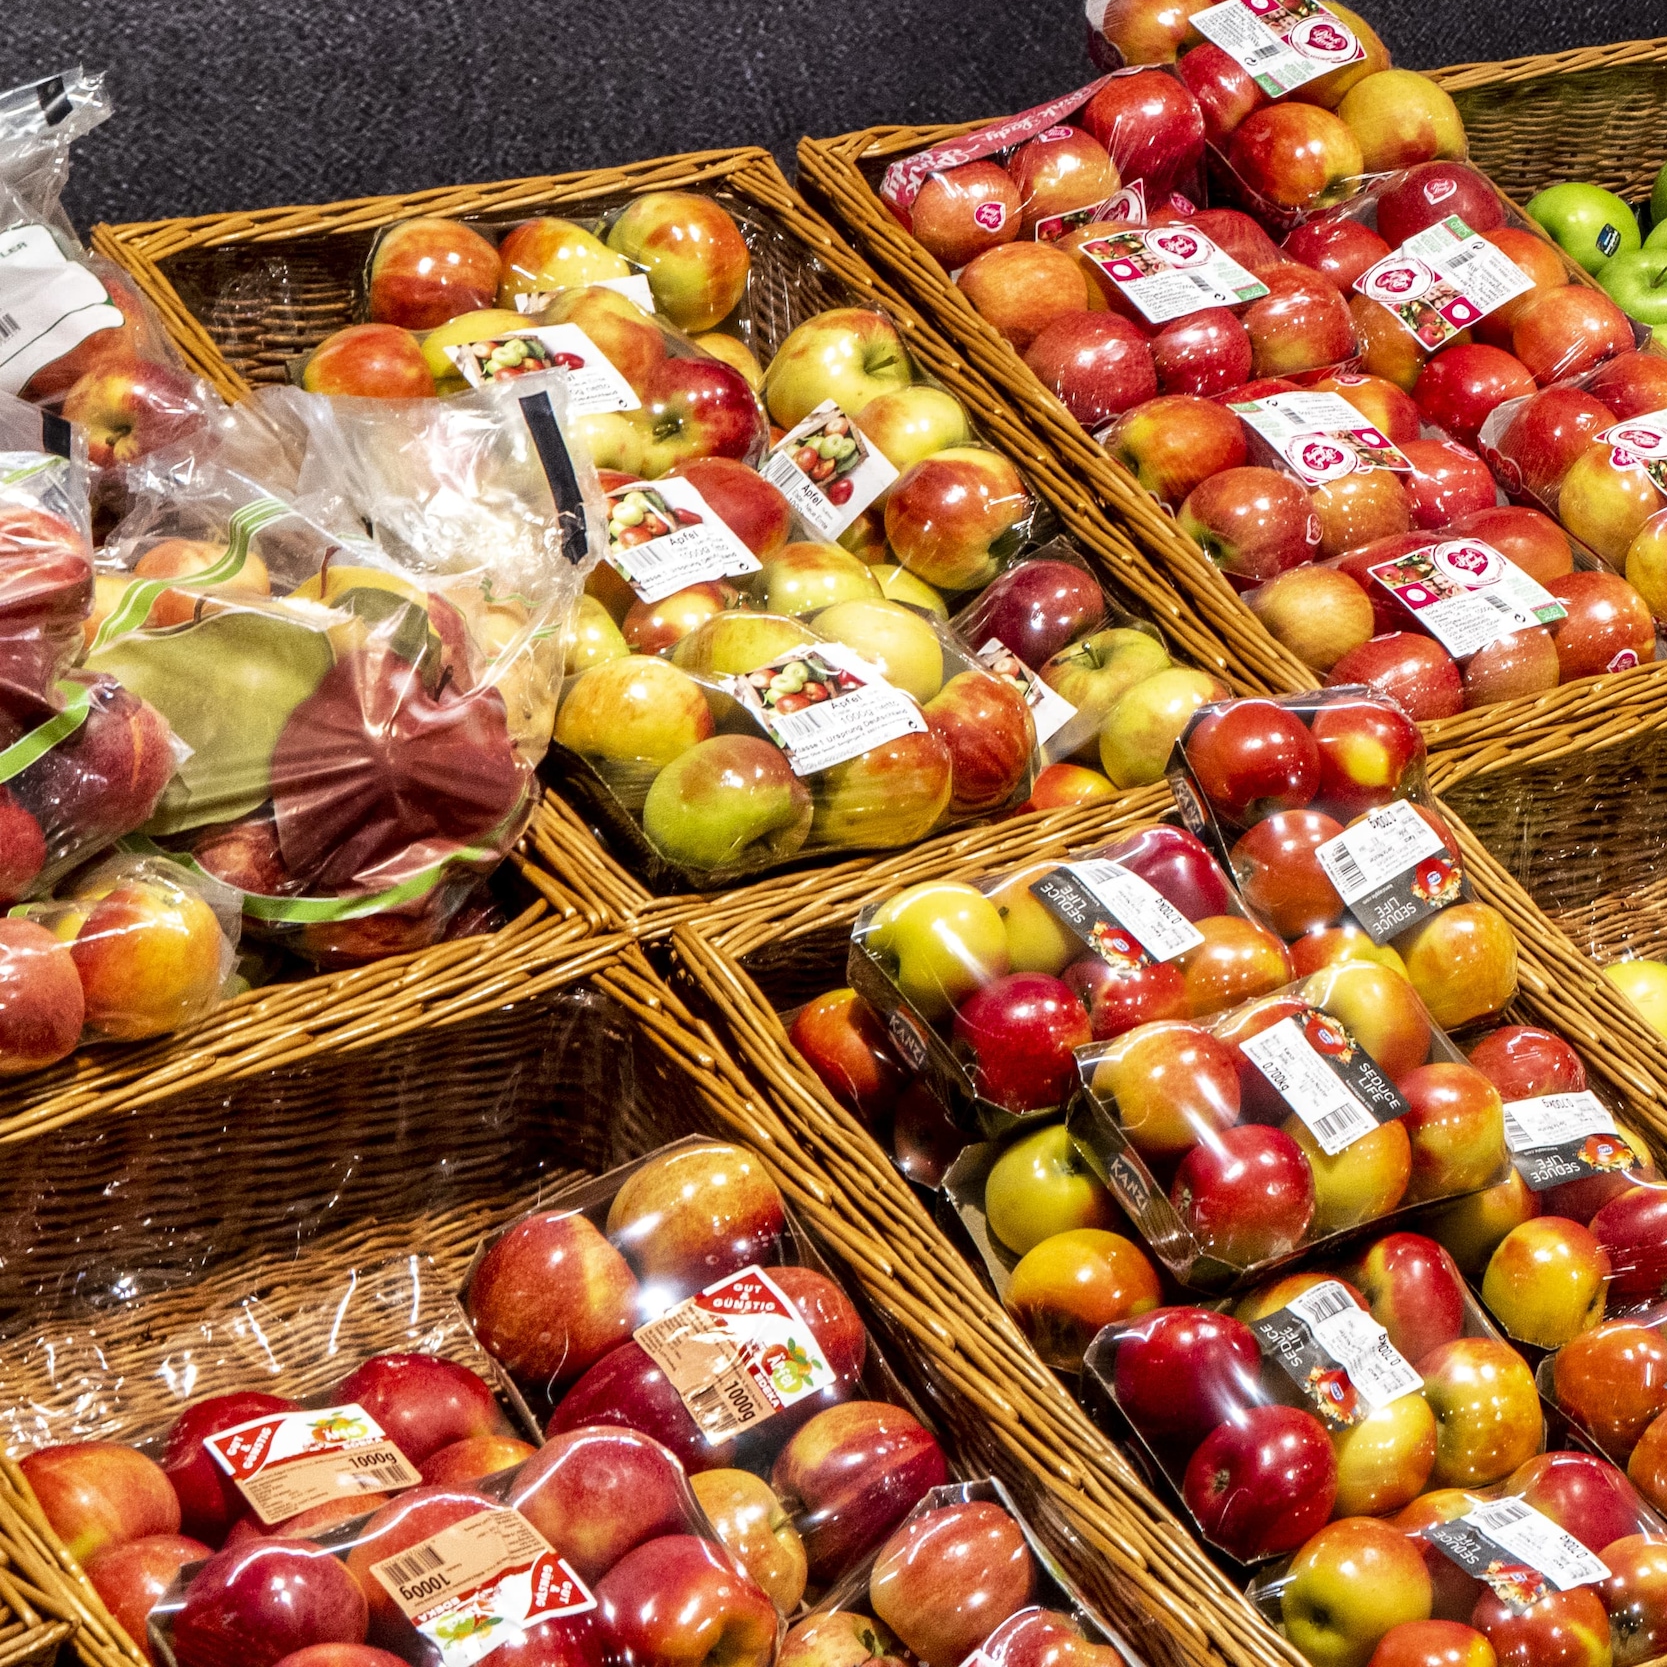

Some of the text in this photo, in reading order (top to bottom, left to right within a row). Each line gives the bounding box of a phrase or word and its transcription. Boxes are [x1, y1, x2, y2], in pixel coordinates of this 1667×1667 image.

[800, 482, 824, 508] Apfel
[668, 530, 700, 548] Apfel
[830, 693, 864, 711] Apfel
[839, 709, 871, 726] 1000g
[1038, 881, 1086, 925] SEDUCE
[1061, 883, 1088, 911] LIFE
[1374, 895, 1402, 918] LIFE
[1372, 901, 1418, 935] SEDUCE
[888, 1014, 927, 1070] KANZI
[1358, 1061, 1402, 1110] SEDUCE
[1358, 1075, 1383, 1105] LIFE
[1530, 1161, 1582, 1183] SEDUCE
[1538, 1155, 1565, 1171] LIFE
[1109, 1157, 1150, 1212] KANZI
[733, 1282, 763, 1294] GUT
[739, 1293, 751, 1302] &
[711, 1294, 777, 1312] GÜNSTIG
[1258, 1323, 1303, 1368] SEDUCE
[766, 1351, 797, 1389] Äpfel
[725, 1378, 757, 1424] 1000g
[752, 1371, 782, 1411] EDEKA
[225, 1435, 246, 1457] GUT
[240, 1442, 253, 1453] &
[242, 1426, 273, 1471] GÜNSTIG
[347, 1452, 398, 1470] 1000g
[1432, 1530, 1481, 1566] SEDUCE
[1451, 1532, 1480, 1554] LIFE
[399, 1571, 452, 1602] 1000g
[533, 1563, 555, 1609] GÜNSTIG
[547, 1583, 561, 1595] &
[559, 1578, 574, 1605] GUT
